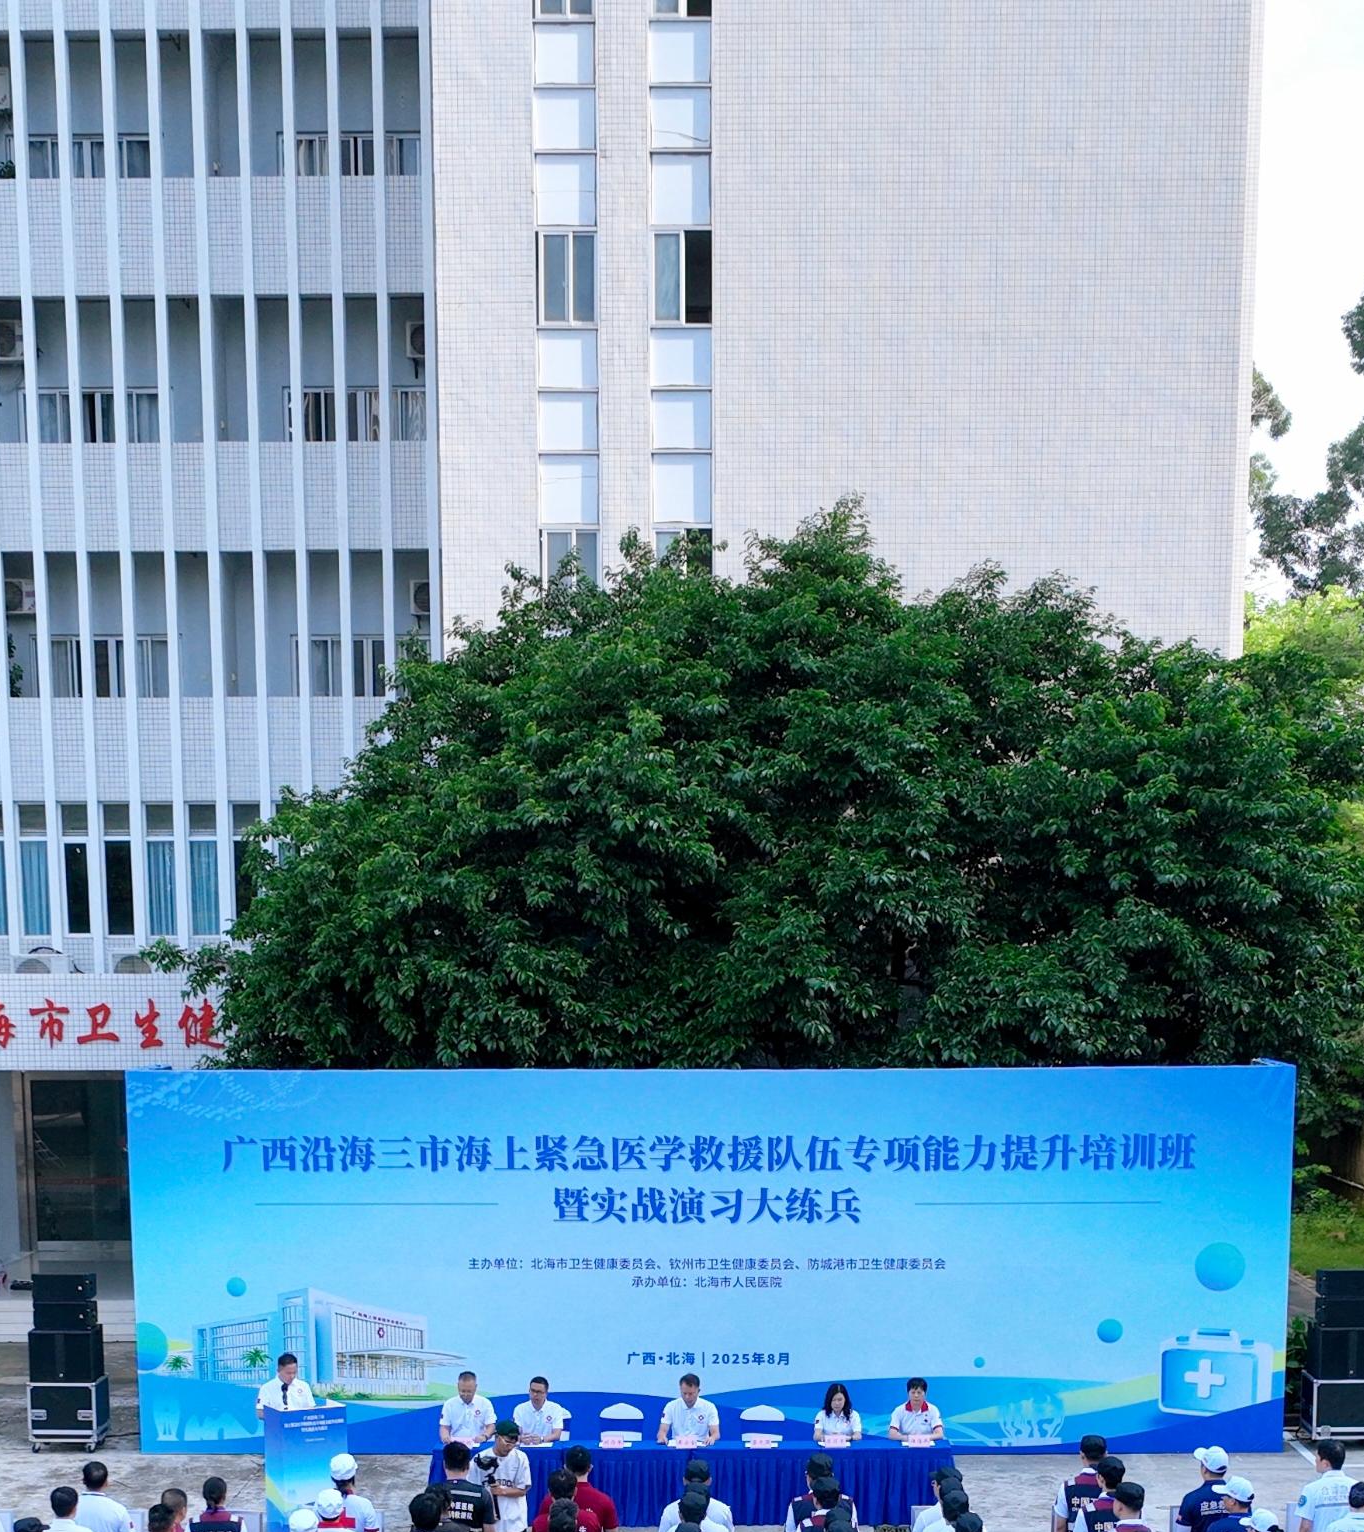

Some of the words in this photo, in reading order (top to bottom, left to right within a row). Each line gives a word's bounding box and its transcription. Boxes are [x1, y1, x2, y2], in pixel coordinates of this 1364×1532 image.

[222, 1133, 1196, 1173] 广西沿海三市海上紧急医学救援队伍专项能力提升培训班
[554, 1186, 861, 1225] 暨实战演习大练兵
[712, 1352, 790, 1366] 2025年8月
[1071, 1496, 1097, 1506] 中国
[1094, 1521, 1119, 1532] 中国
